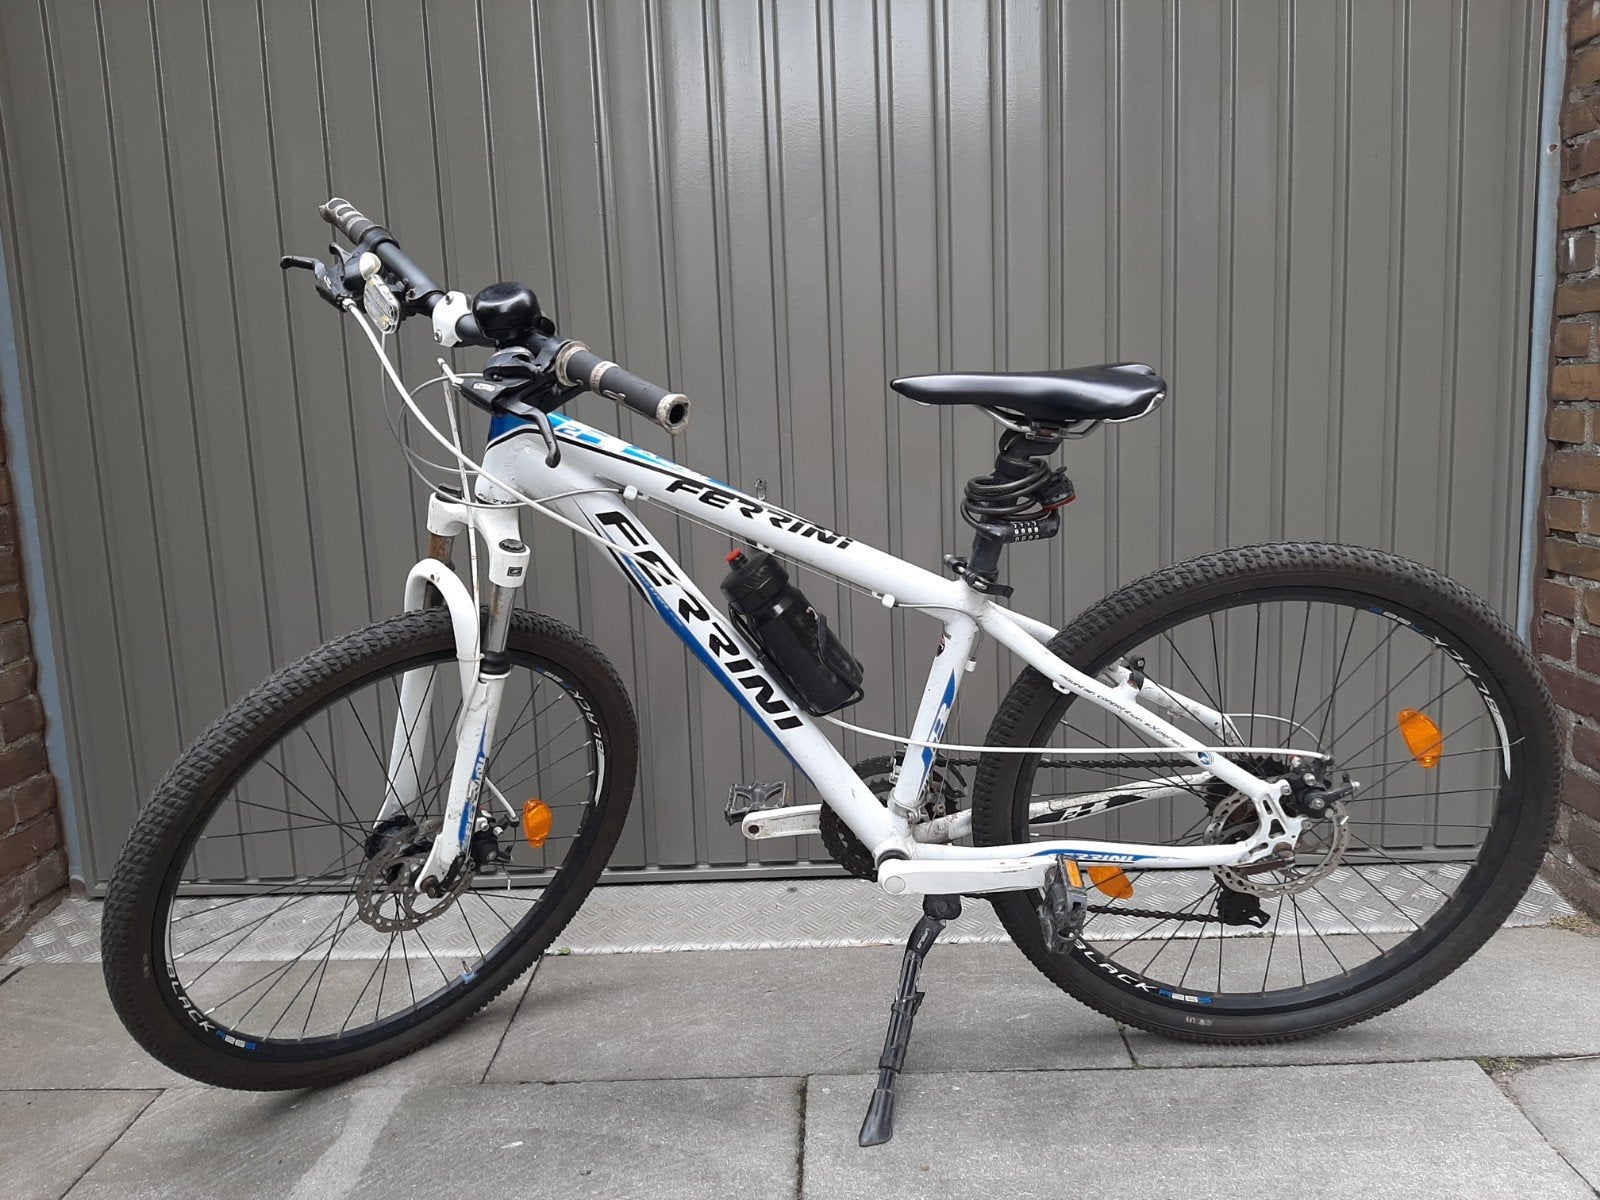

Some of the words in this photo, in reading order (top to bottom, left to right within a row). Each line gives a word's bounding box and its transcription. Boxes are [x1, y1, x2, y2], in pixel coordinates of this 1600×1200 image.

[665, 480, 854, 549] FERRINI
[595, 511, 804, 731] FERRINI
[1423, 634, 1500, 715] BLACK
[568, 690, 604, 753] BLACK
[166, 962, 216, 1032] BLACK
[1074, 938, 1158, 993] BLACK
